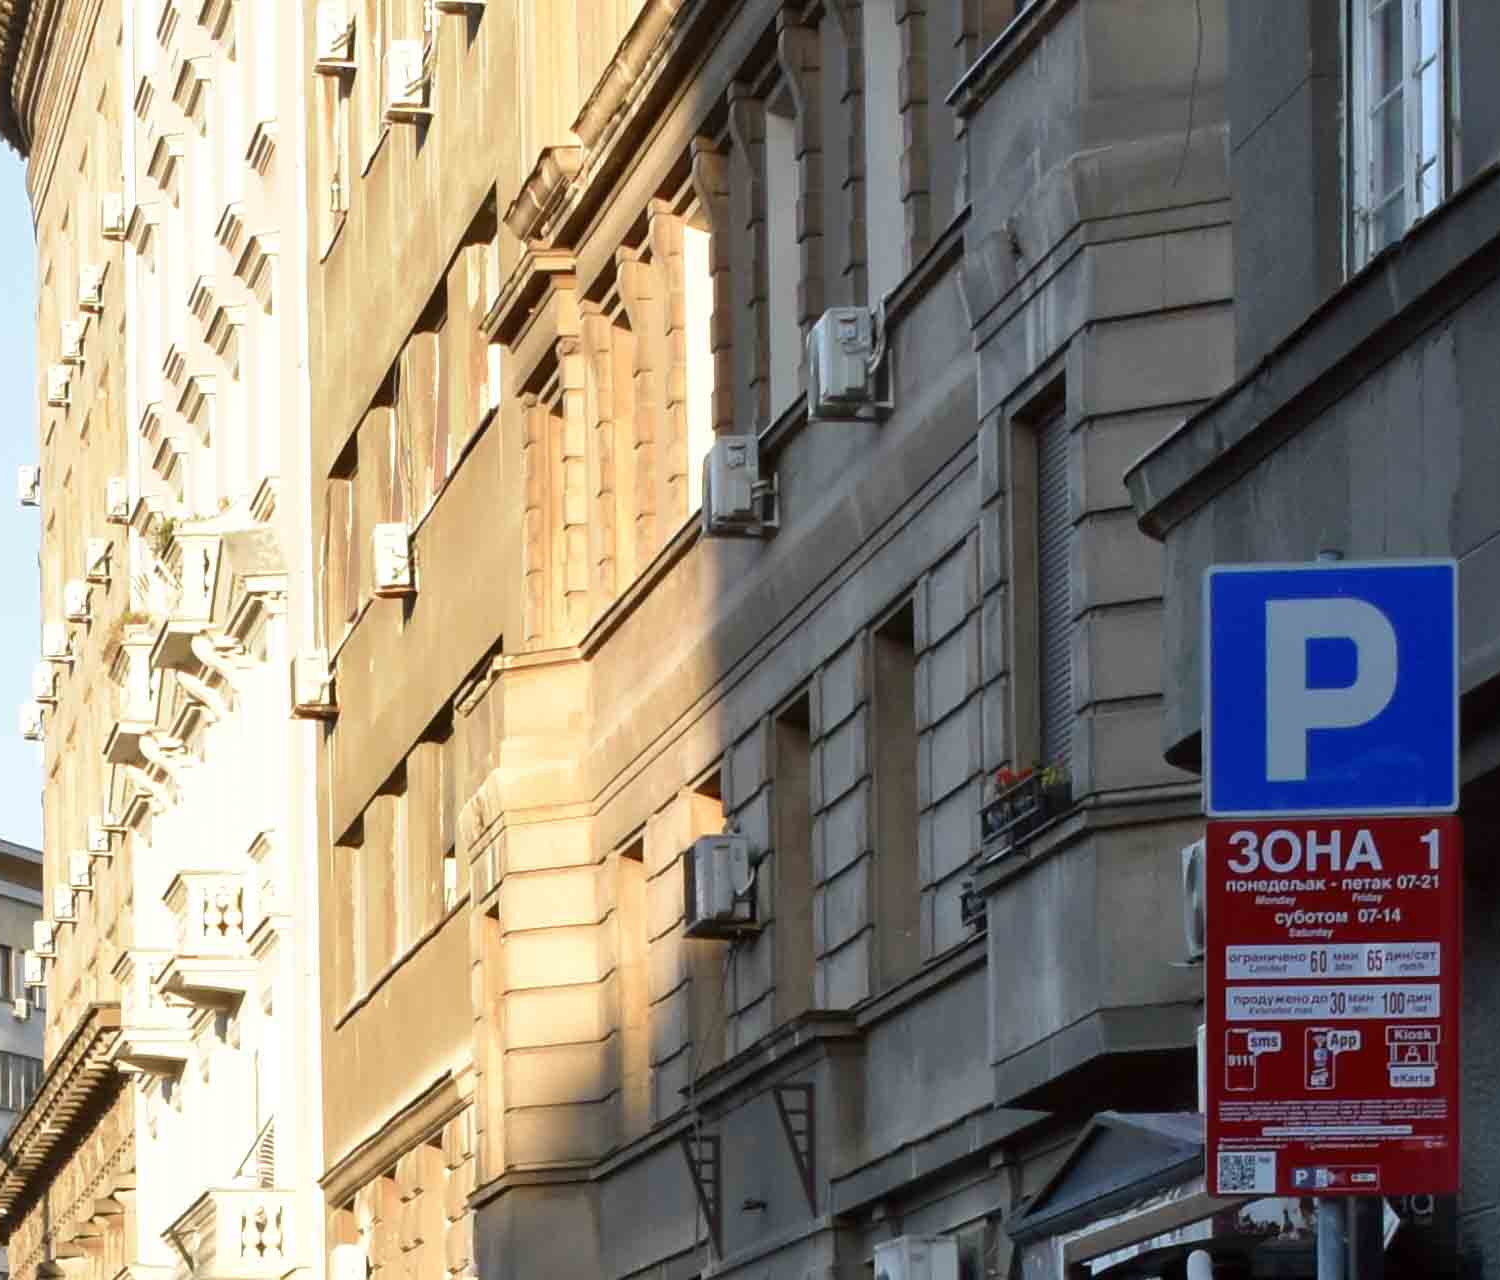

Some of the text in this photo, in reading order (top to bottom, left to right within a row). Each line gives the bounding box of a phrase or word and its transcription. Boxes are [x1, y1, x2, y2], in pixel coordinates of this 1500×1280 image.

[1265, 598, 1398, 782] P
[1227, 828, 1441, 873] ЗОНА 1
[1225, 874, 1440, 894] понедељак петак 07-21
[1274, 907, 1402, 928] суботом 07-14
[1310, 950, 1328, 974] 60
[1367, 949, 1383, 972] 65
[1329, 992, 1346, 1014] 30
[1382, 991, 1406, 1014] 100
[1250, 1035, 1279, 1048] sms
[1329, 1033, 1358, 1050] App
[1393, 1029, 1432, 1041] Kiosk
